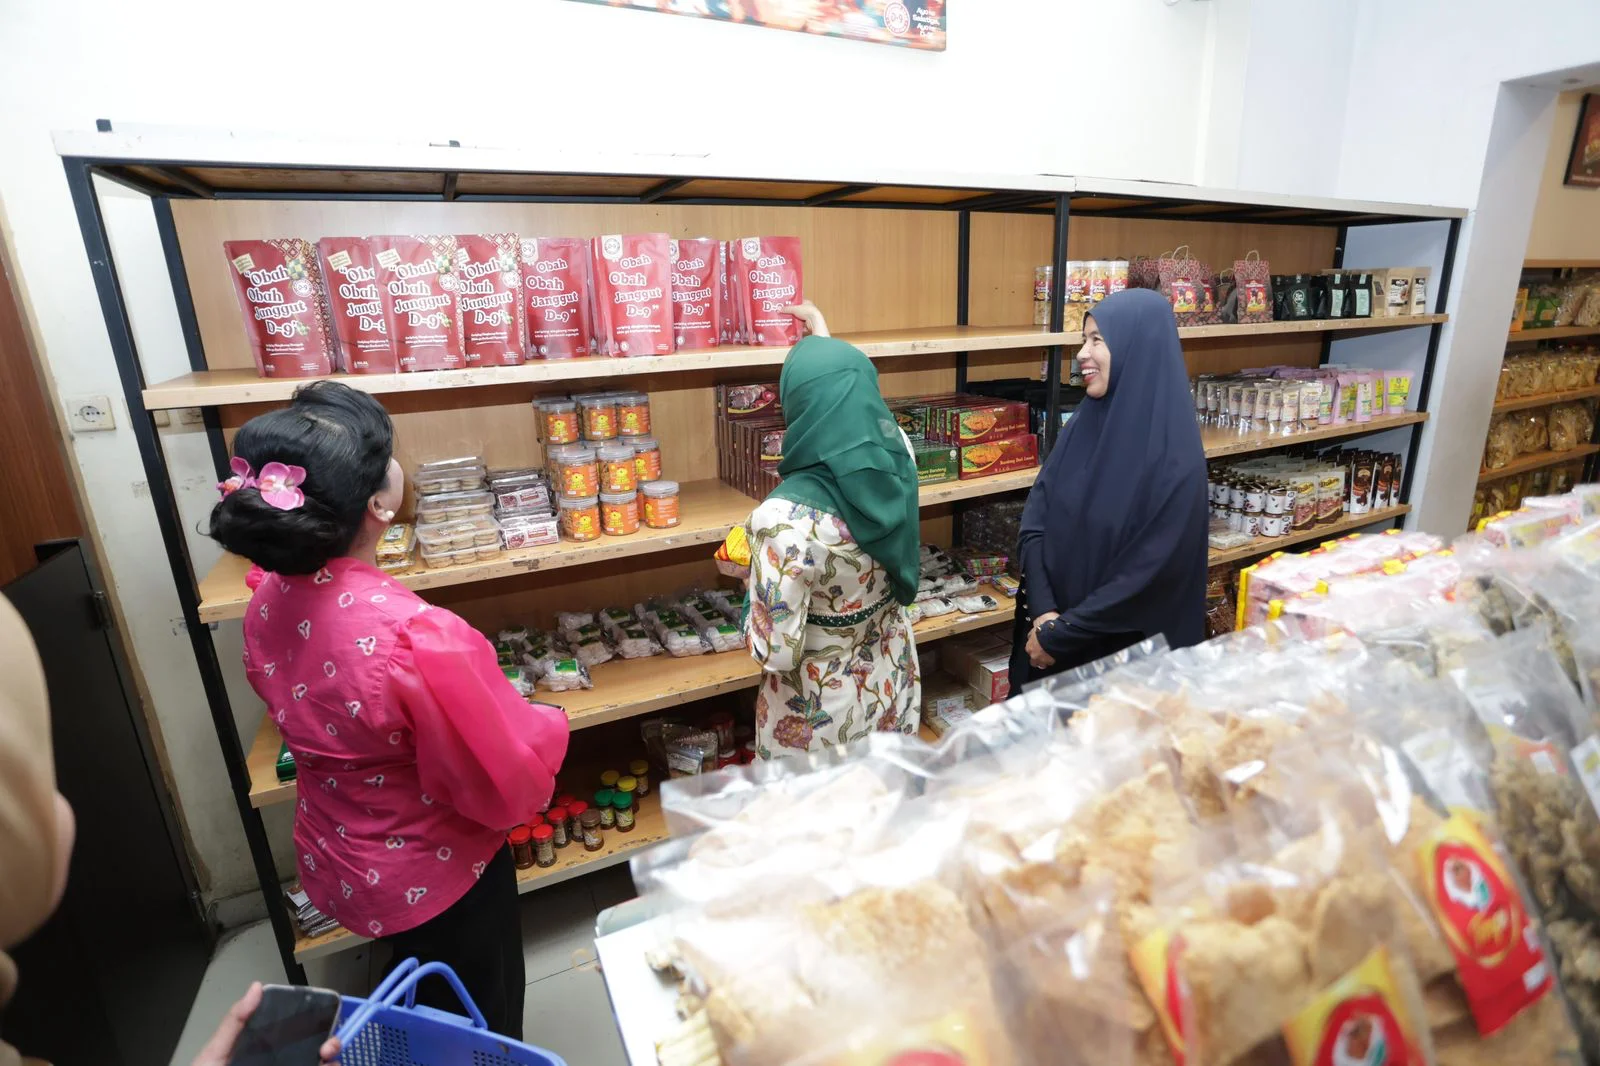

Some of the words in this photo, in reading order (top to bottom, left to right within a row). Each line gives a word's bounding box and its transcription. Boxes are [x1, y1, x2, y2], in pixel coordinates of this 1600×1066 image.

[537, 258, 568, 273] Obah
[620, 254, 652, 269] Obah
[677, 257, 704, 272] Obah
[758, 256, 786, 268] Obah
[526, 275, 564, 290] Obah
[609, 272, 647, 286] Obah
[749, 271, 782, 285] Obah
[340, 284, 381, 299] Obah
[388, 281, 432, 296] Obah
[460, 280, 494, 295] Obah
[614, 287, 662, 303] Janggut
[672, 287, 712, 302] Janggut
[752, 285, 795, 300] Janggut
[247, 288, 284, 303] Obah
[462, 292, 513, 312] Janggut
[531, 291, 579, 307] Janggut
[254, 300, 307, 320] Janggut
[394, 294, 452, 313] Janggut
